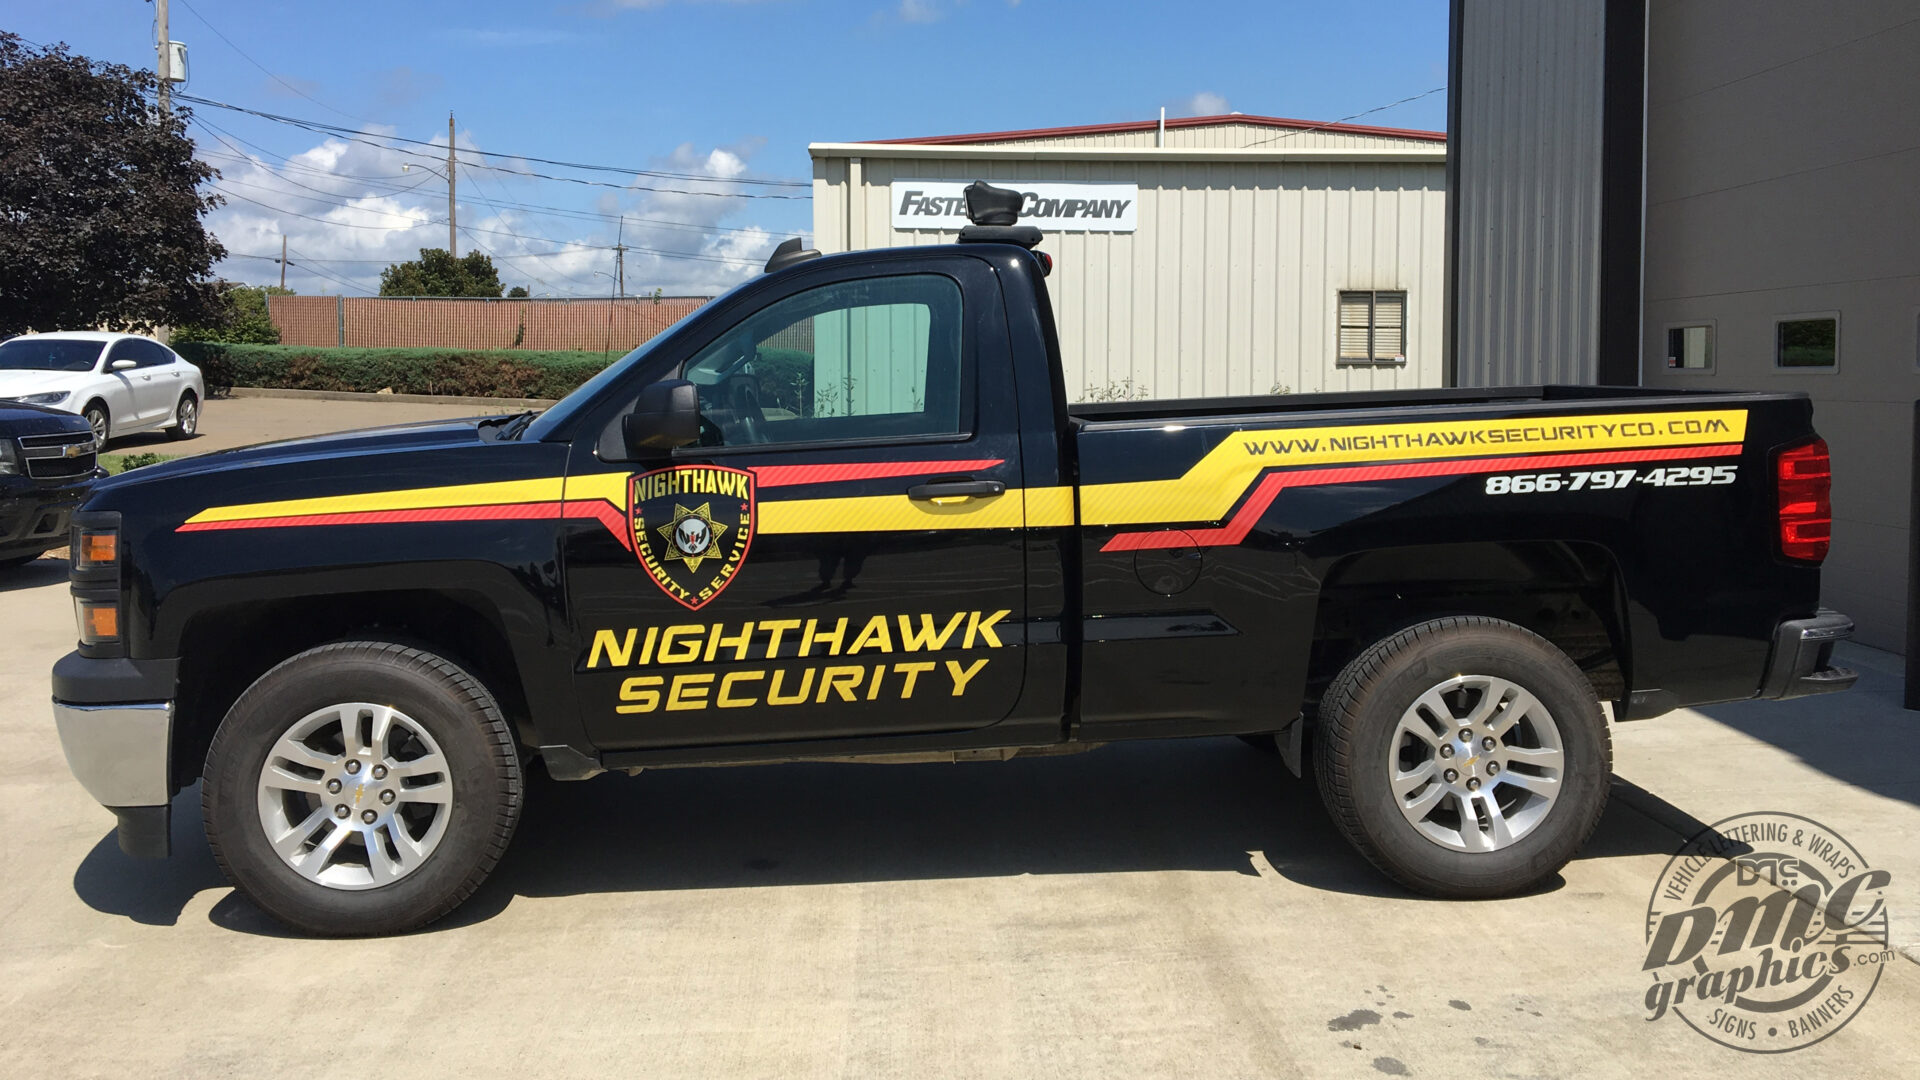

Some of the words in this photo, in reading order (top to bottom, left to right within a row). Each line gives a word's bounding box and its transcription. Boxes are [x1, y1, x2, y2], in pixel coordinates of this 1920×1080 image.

[899, 191, 966, 216] FASTE
[1018, 192, 1131, 219] COMPANY
[1243, 419, 1730, 455] WWW.NIGHTHAWKSECURITYCO.COM
[634, 469, 749, 504] NIGHTHAWK
[1485, 465, 1738, 495] 866-797-4295
[634, 517, 690, 600] SECURITY
[698, 513, 750, 600] SERVICE
[587, 609, 1012, 668] NIGHTHAWK
[616, 659, 990, 715] SECURITY
